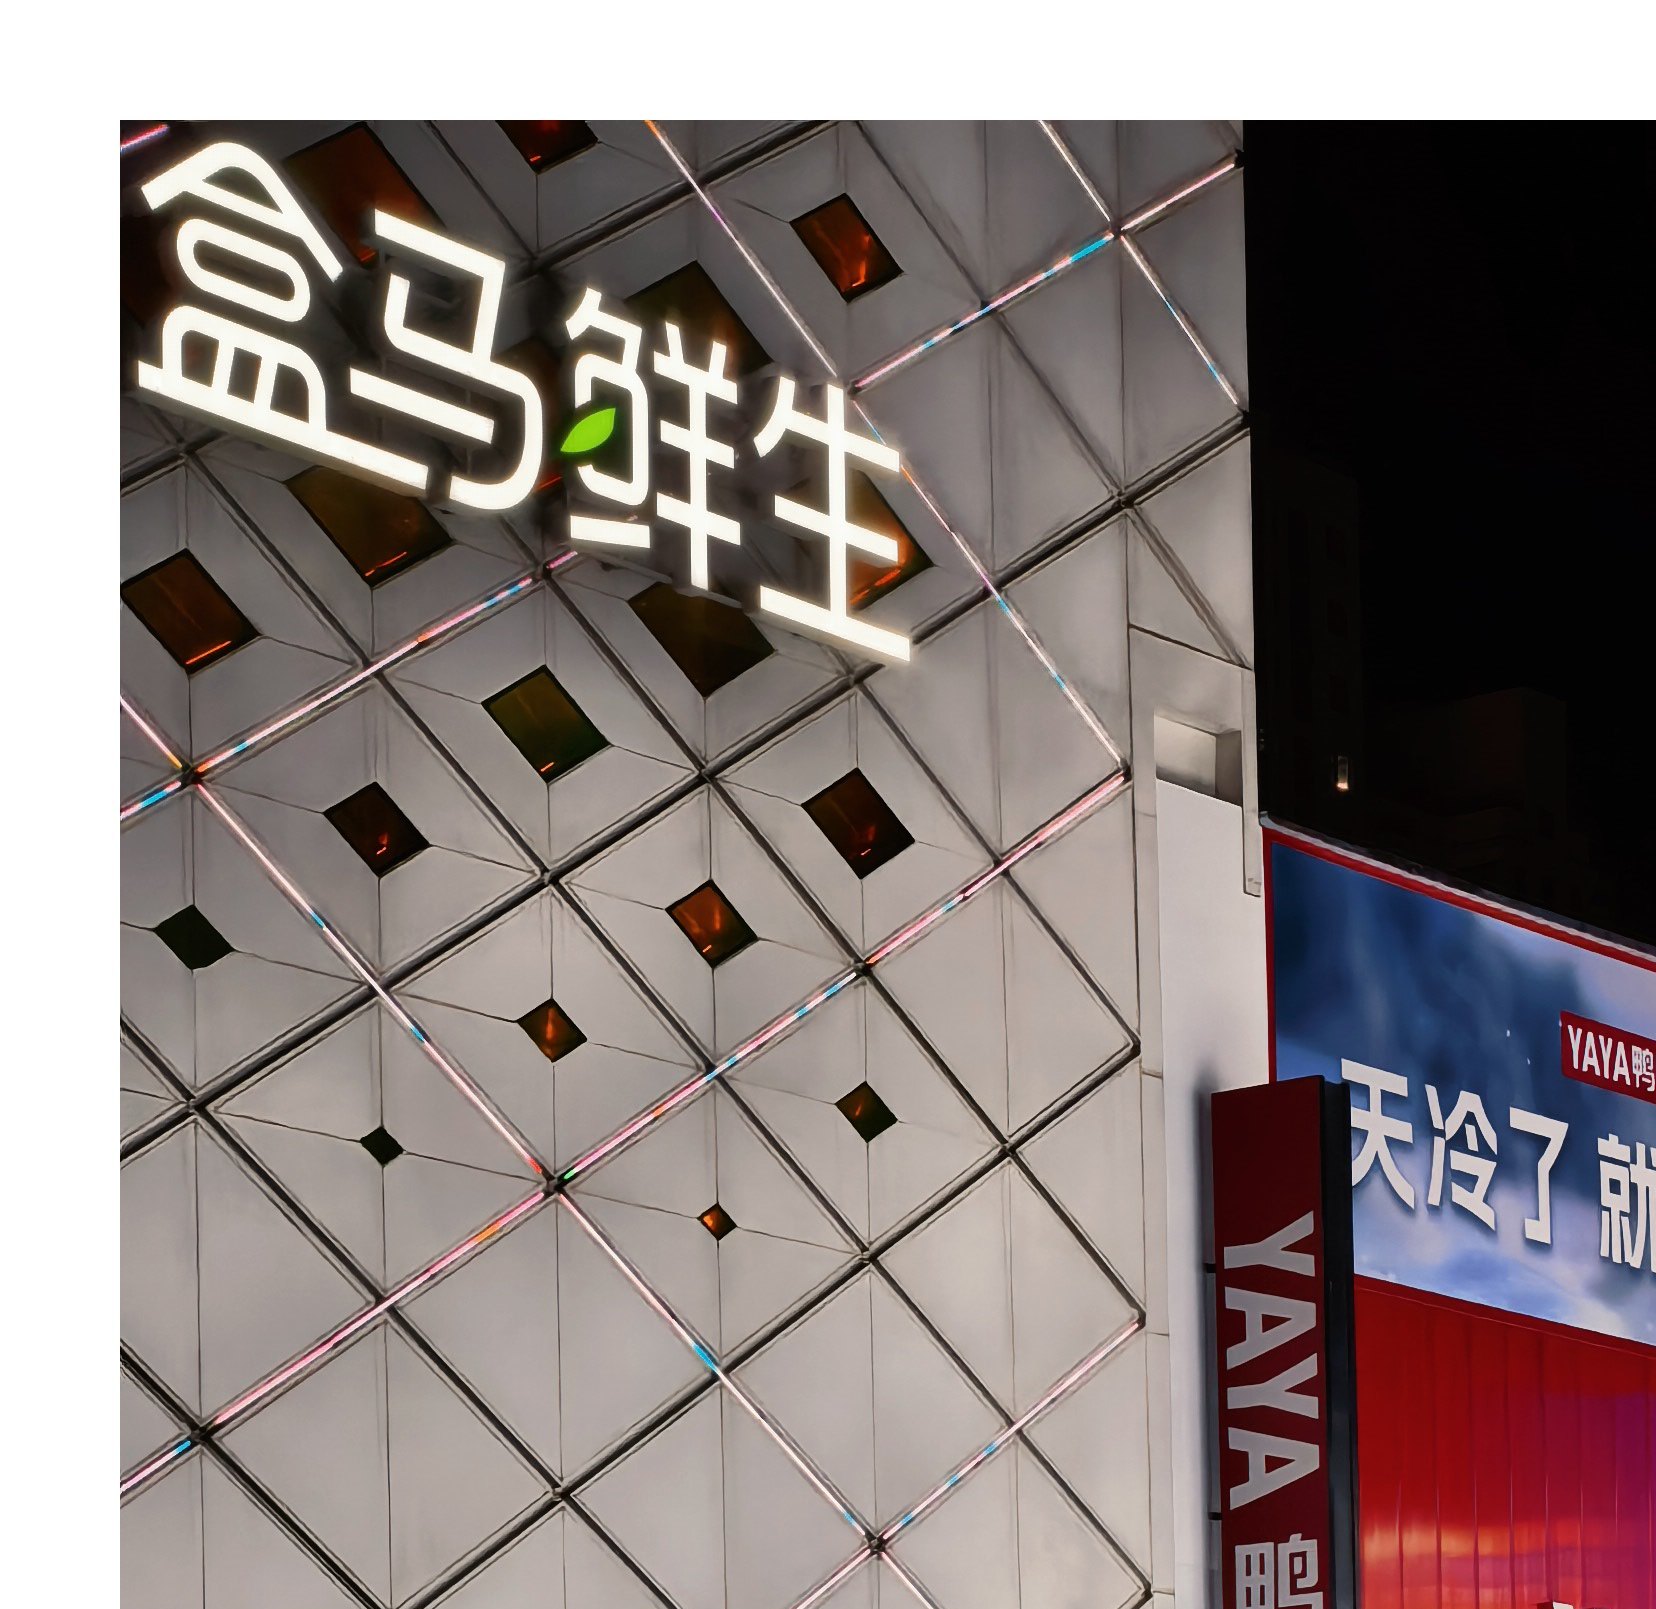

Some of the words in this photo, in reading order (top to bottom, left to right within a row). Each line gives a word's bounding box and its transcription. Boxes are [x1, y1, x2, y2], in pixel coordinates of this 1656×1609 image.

[137, 142, 912, 661] 盒马鲜生
[1341, 1058, 1569, 1246] 天冷了
